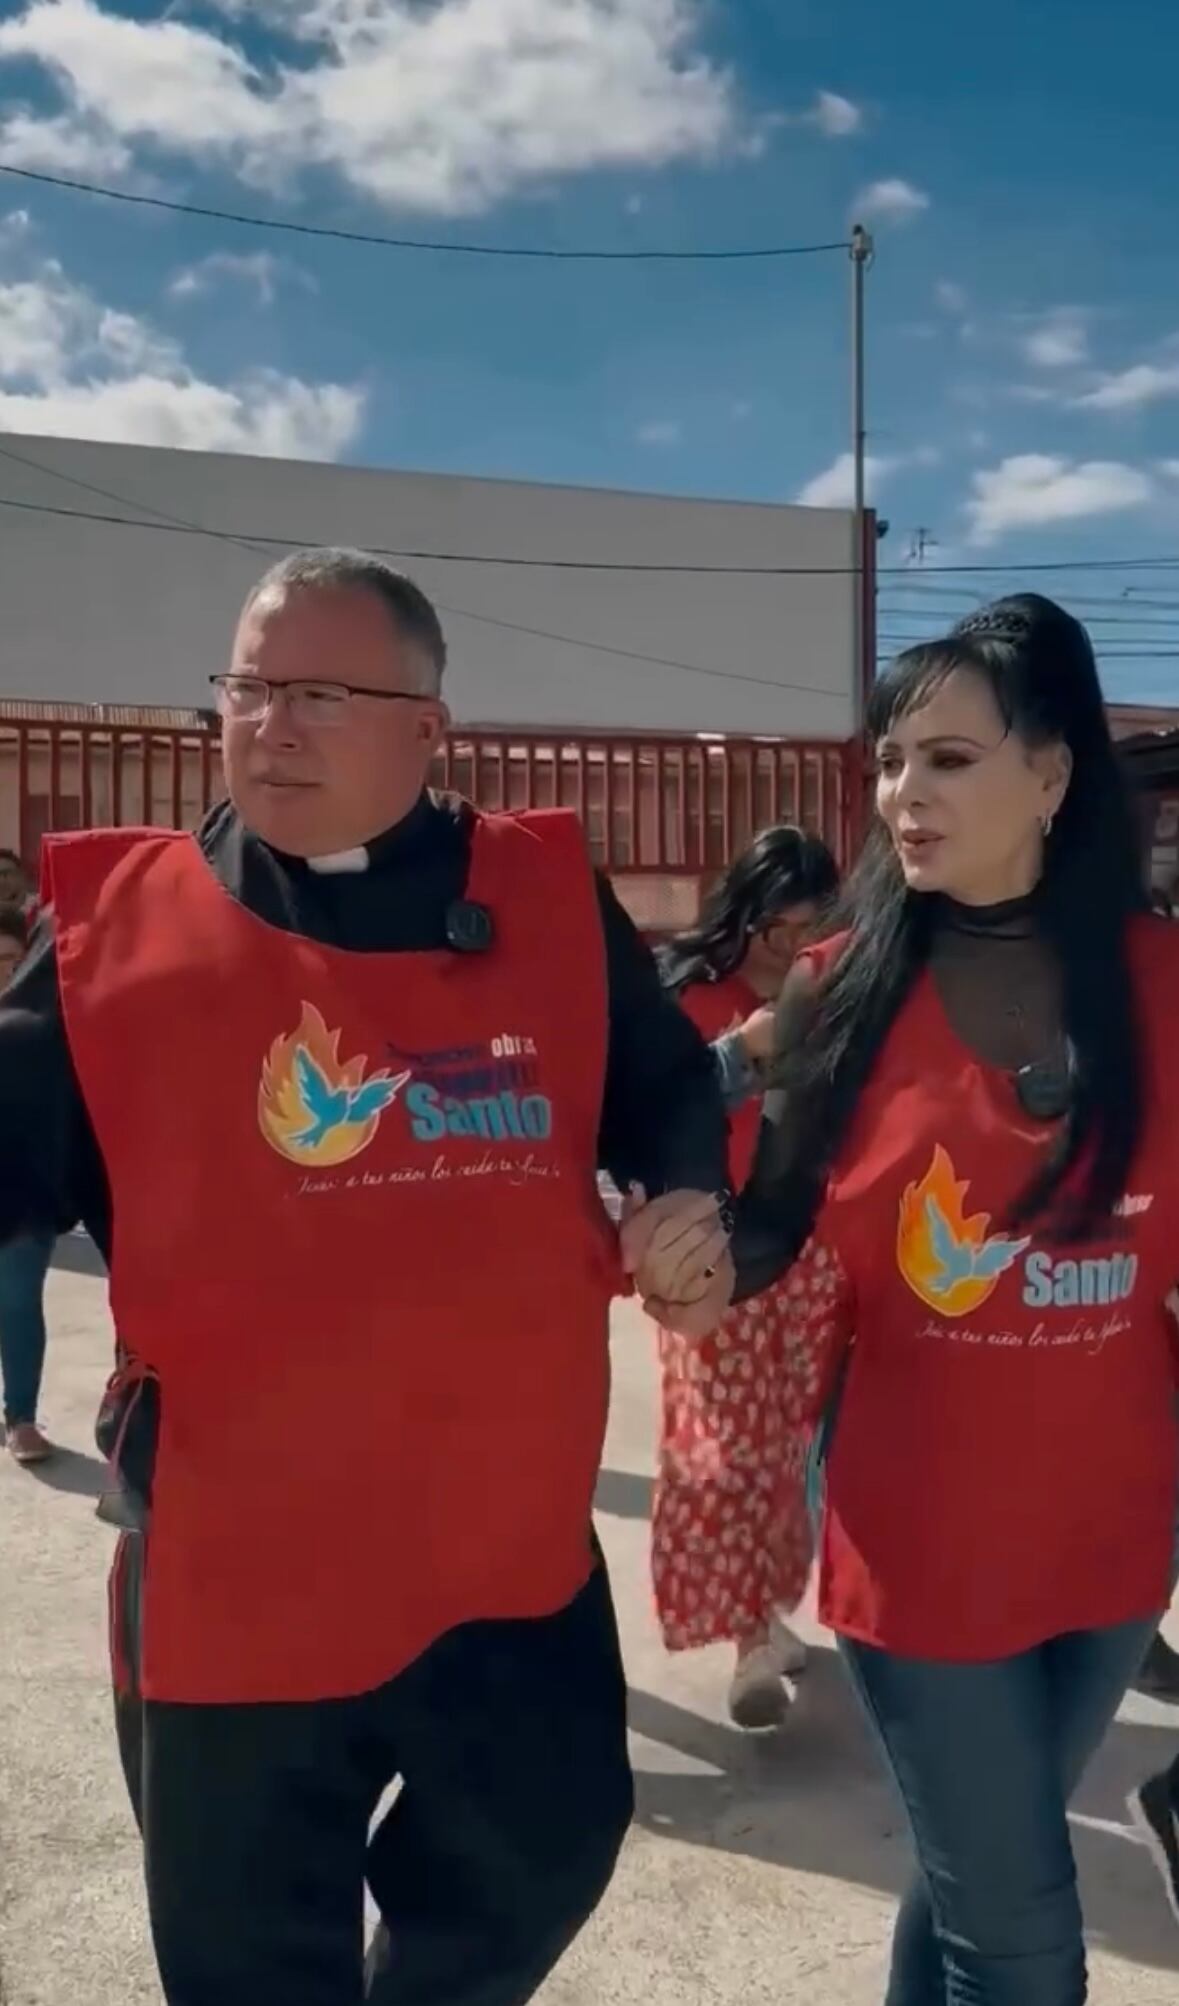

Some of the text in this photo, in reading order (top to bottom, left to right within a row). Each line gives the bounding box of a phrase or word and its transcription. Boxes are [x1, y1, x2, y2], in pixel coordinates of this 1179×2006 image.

[405, 1082, 552, 1142] Santo
[431, 1154, 451, 1180] los
[1023, 1251, 1138, 1308] Santo
